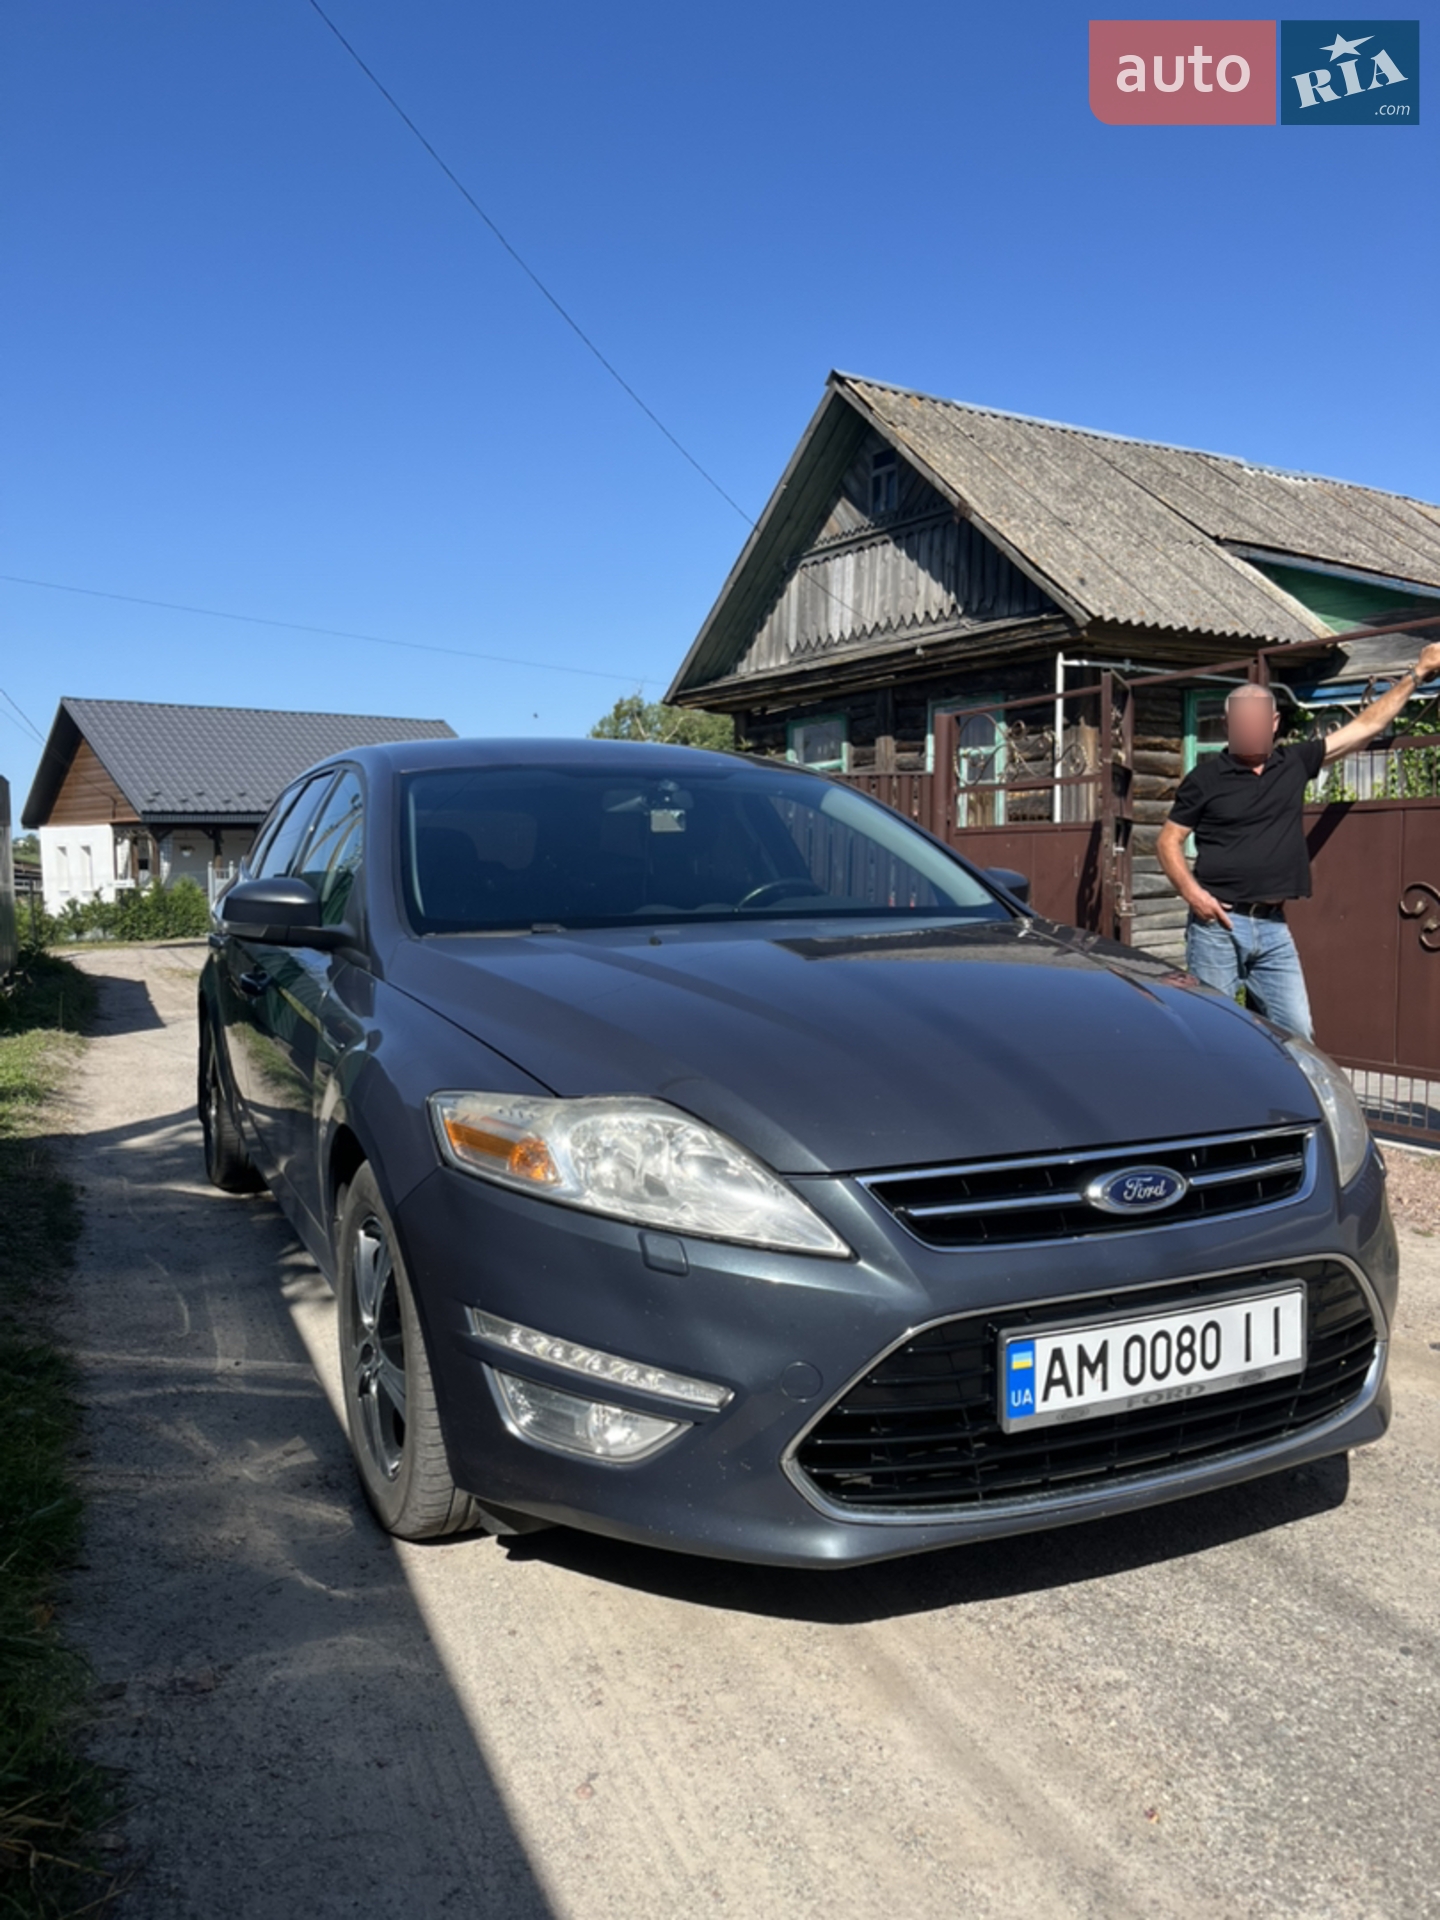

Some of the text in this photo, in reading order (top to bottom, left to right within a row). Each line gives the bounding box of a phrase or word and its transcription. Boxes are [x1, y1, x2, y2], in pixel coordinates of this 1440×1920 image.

[1123, 1176, 1166, 1201] Ford
[1041, 1339, 1109, 1403] AM
[1123, 1320, 1222, 1387] 0080
[1011, 1388, 1033, 1407] UA
[1126, 1384, 1206, 1408] FORD
